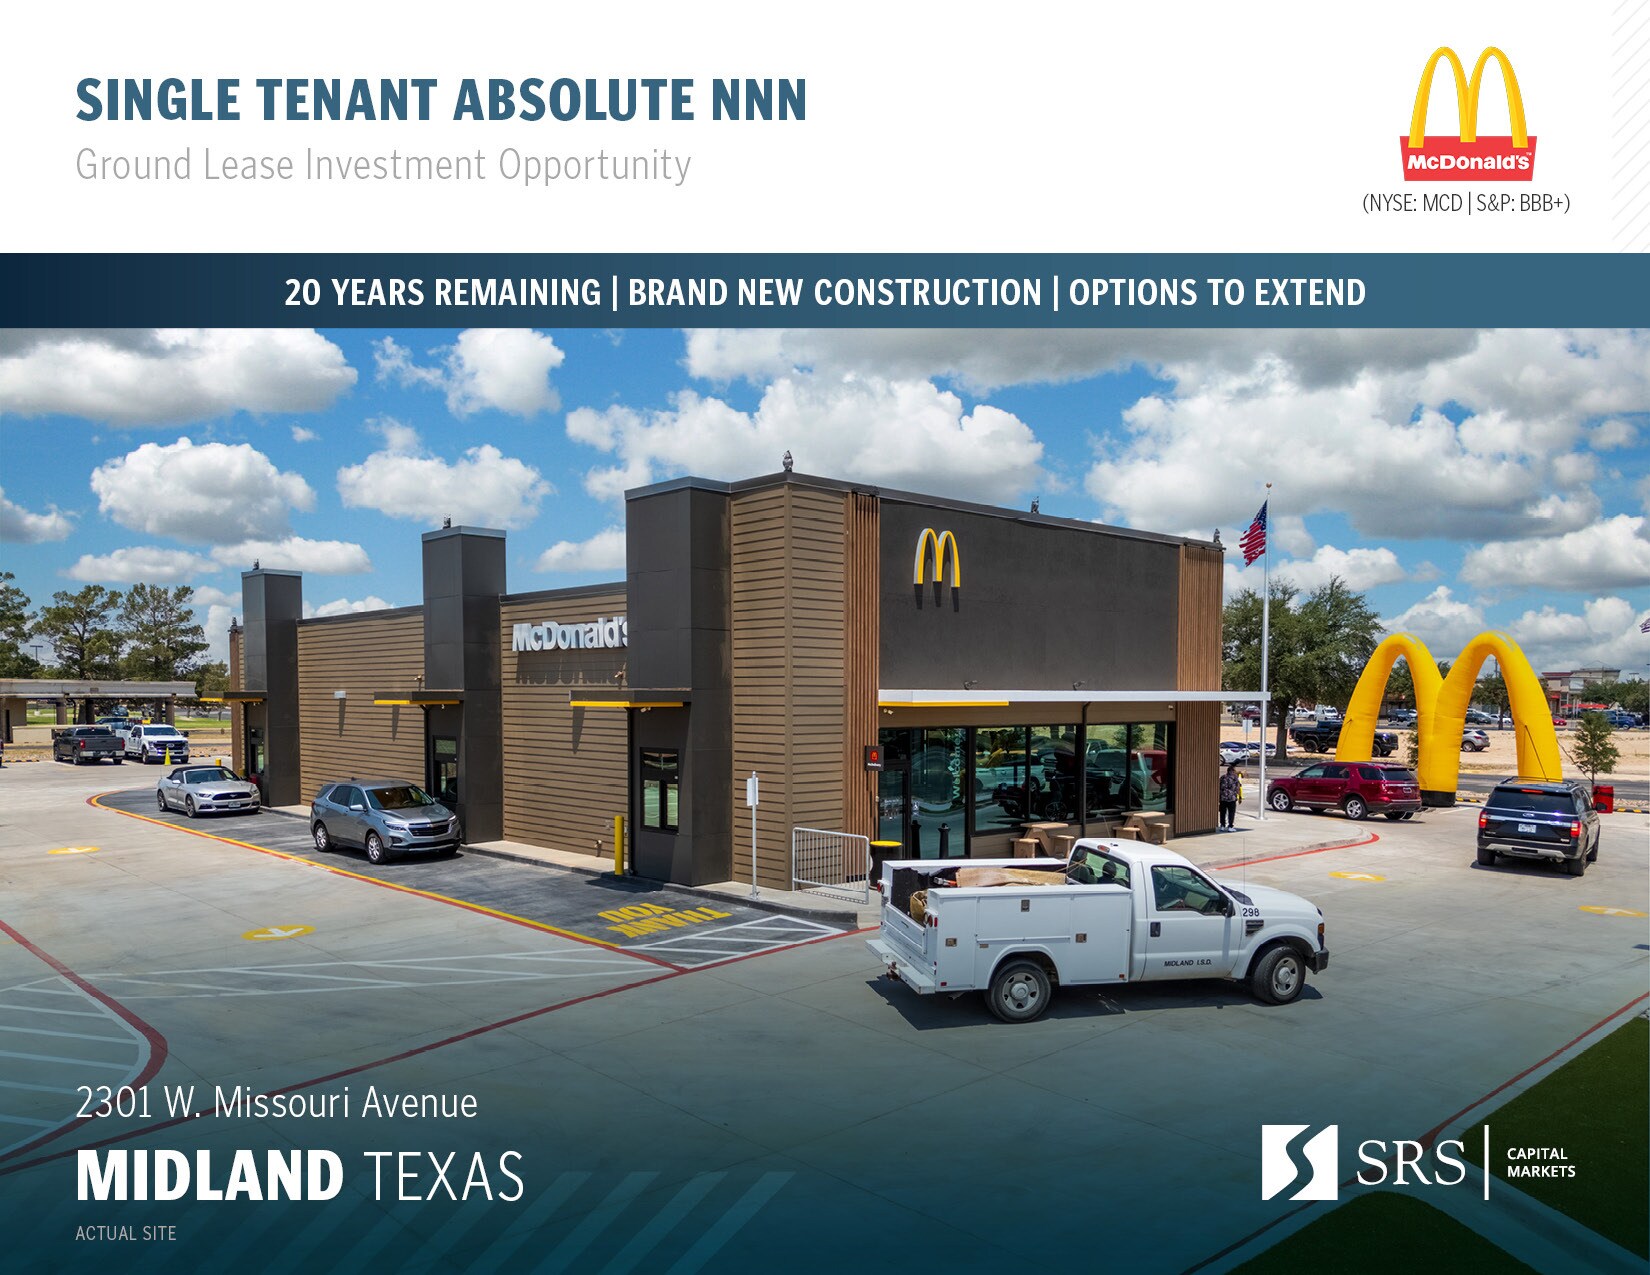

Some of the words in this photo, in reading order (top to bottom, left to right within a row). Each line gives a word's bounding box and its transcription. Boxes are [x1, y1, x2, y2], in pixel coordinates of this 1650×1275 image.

[597, 903, 675, 923] YOU
[1242, 907, 1260, 917] 298
[606, 906, 733, 938] THANK
[1163, 959, 1194, 967] MIDLAND
